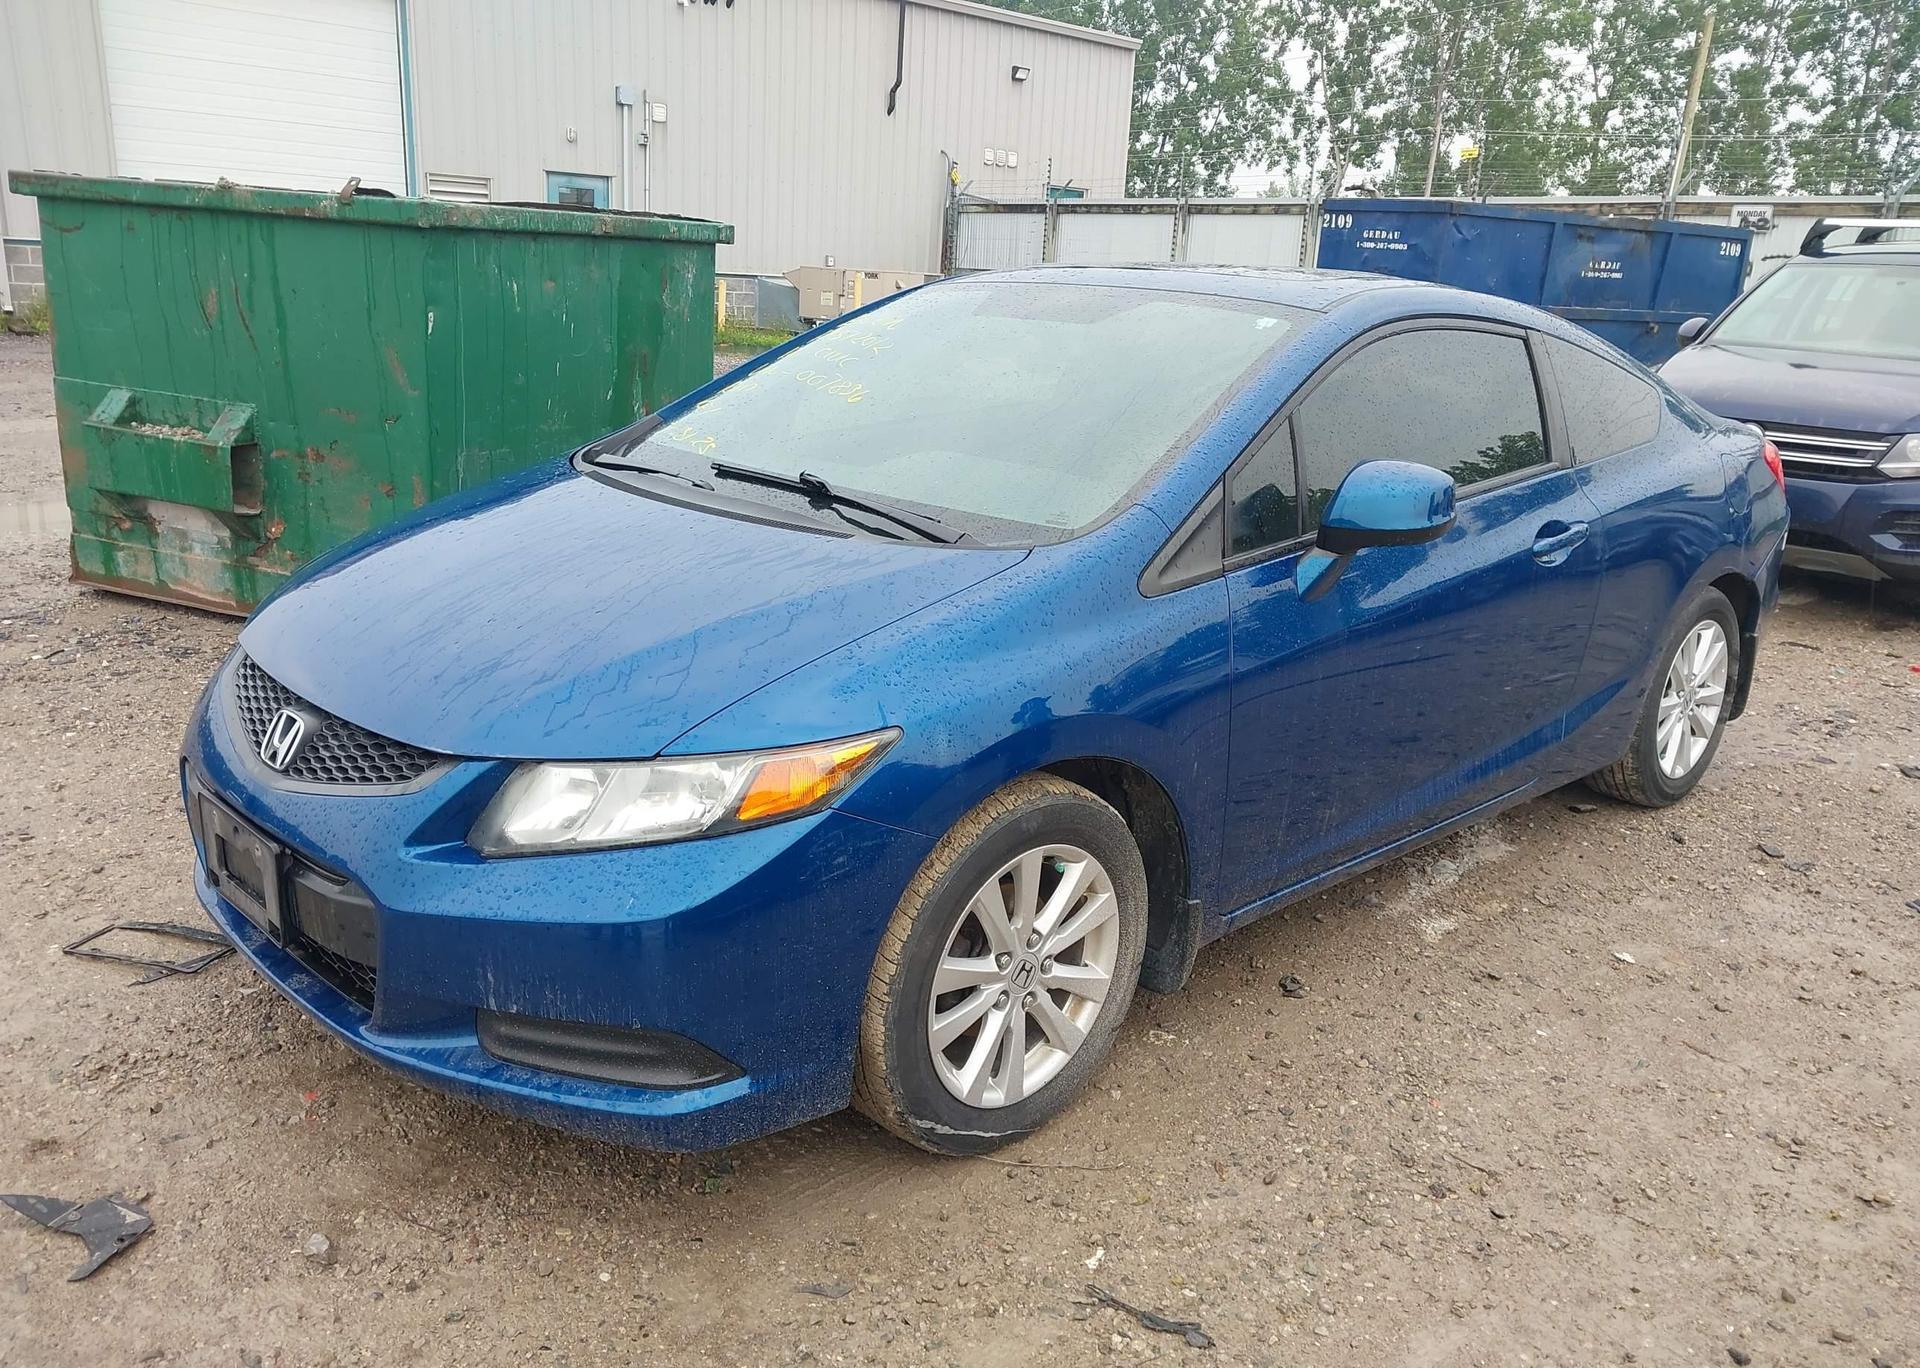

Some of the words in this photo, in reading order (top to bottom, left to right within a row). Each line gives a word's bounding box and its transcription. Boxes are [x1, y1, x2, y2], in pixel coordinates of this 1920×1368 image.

[1736, 209, 1768, 218] MONDAY
[1322, 213, 1353, 229] 2109
[1362, 229, 1401, 240] GERDAU
[1719, 241, 1742, 257] 2109
[864, 271, 880, 280] YORK
